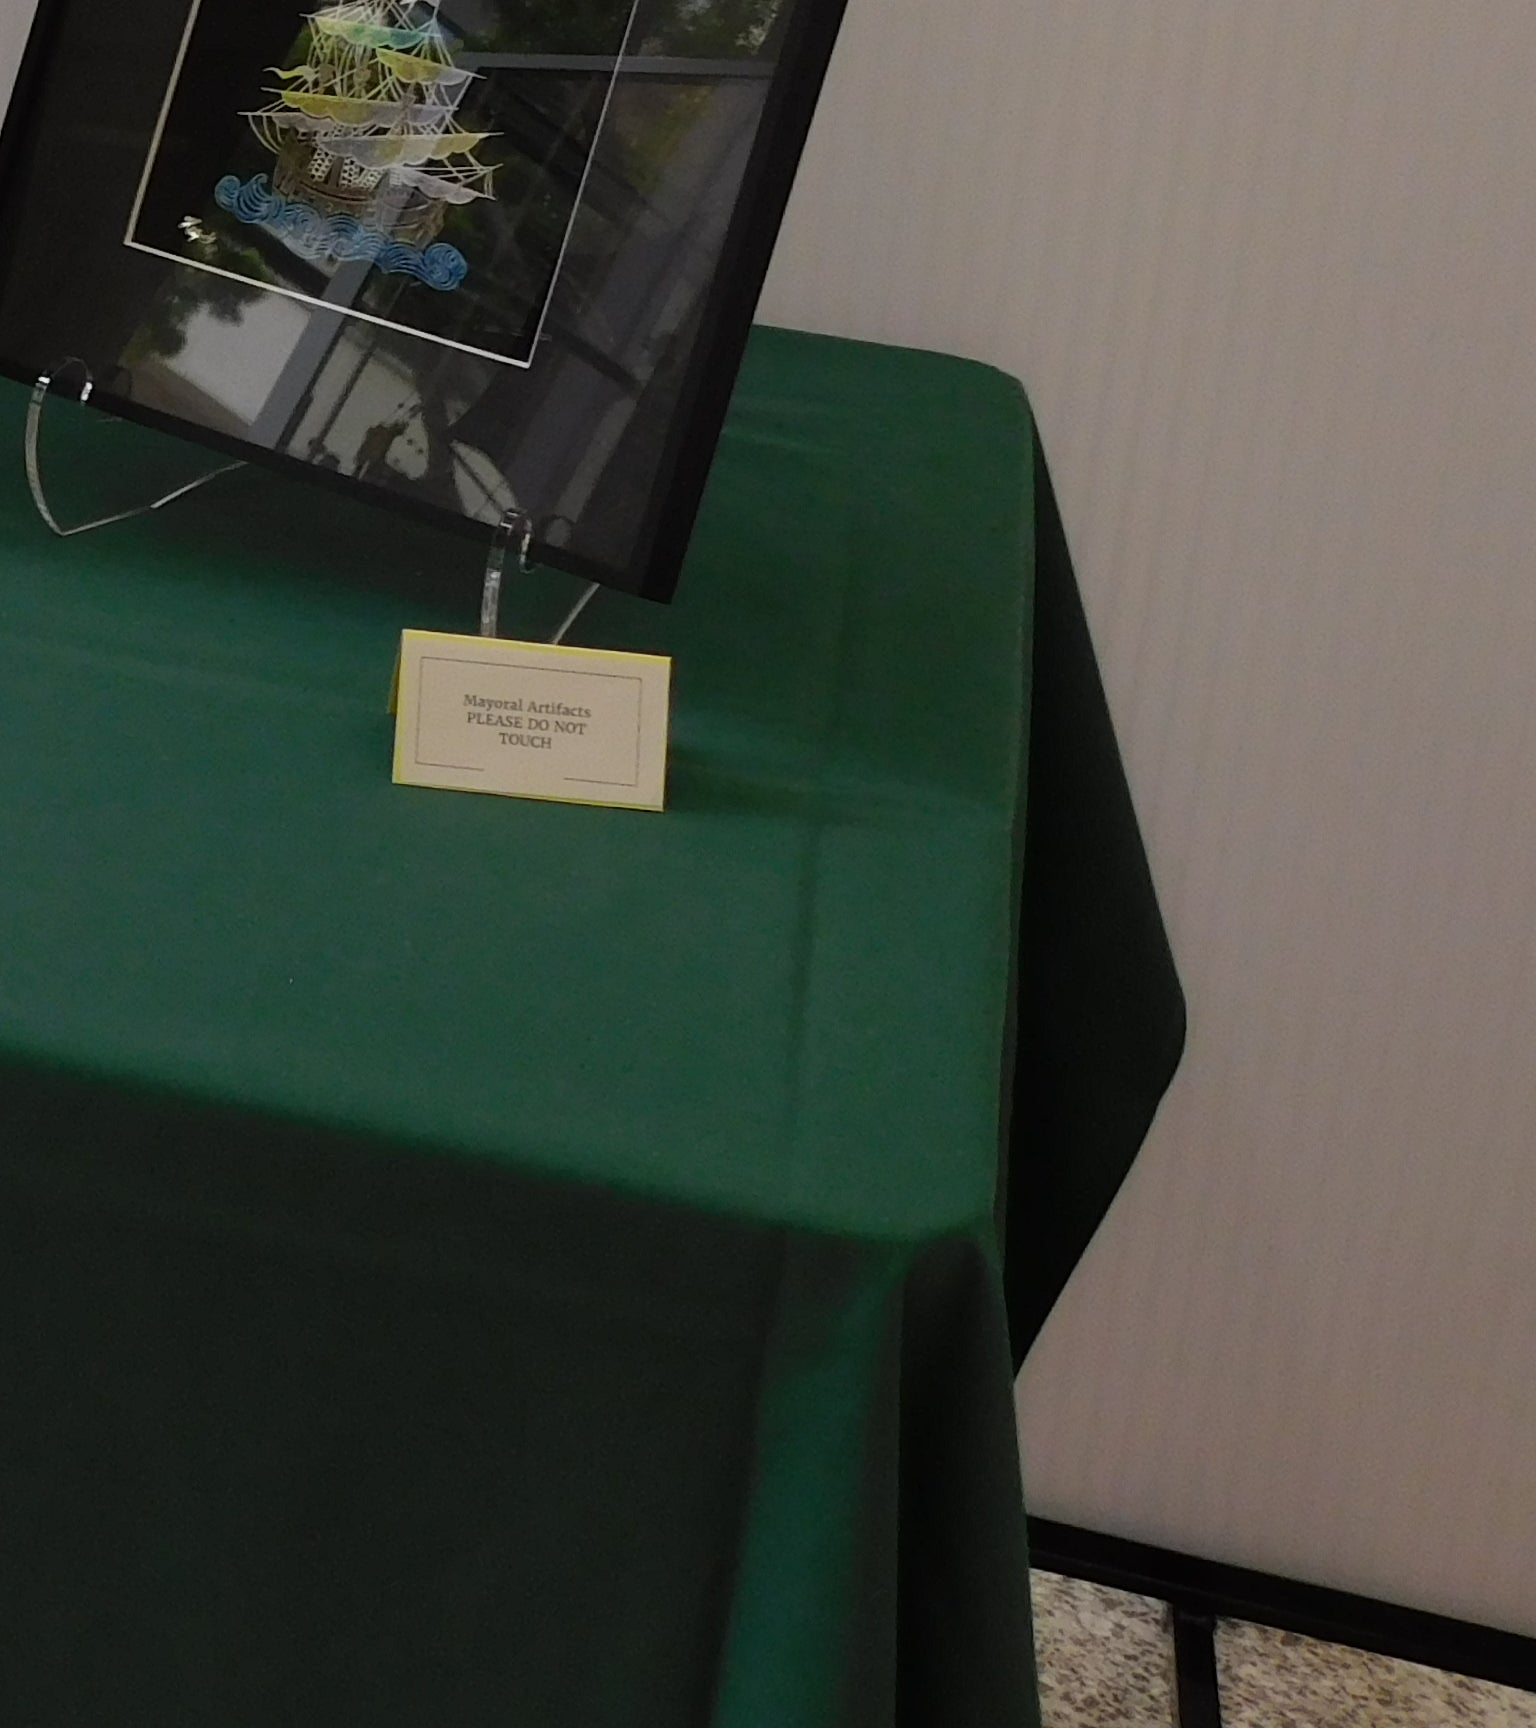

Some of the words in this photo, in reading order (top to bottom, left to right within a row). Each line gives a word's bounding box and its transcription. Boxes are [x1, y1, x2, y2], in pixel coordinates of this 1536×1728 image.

[463, 694, 524, 712] Mayoral
[527, 700, 592, 719] Artifacts
[467, 712, 523, 729] PLEASE
[528, 717, 550, 731] DO
[554, 720, 588, 735] NOT
[499, 732, 552, 750] TOUCH
